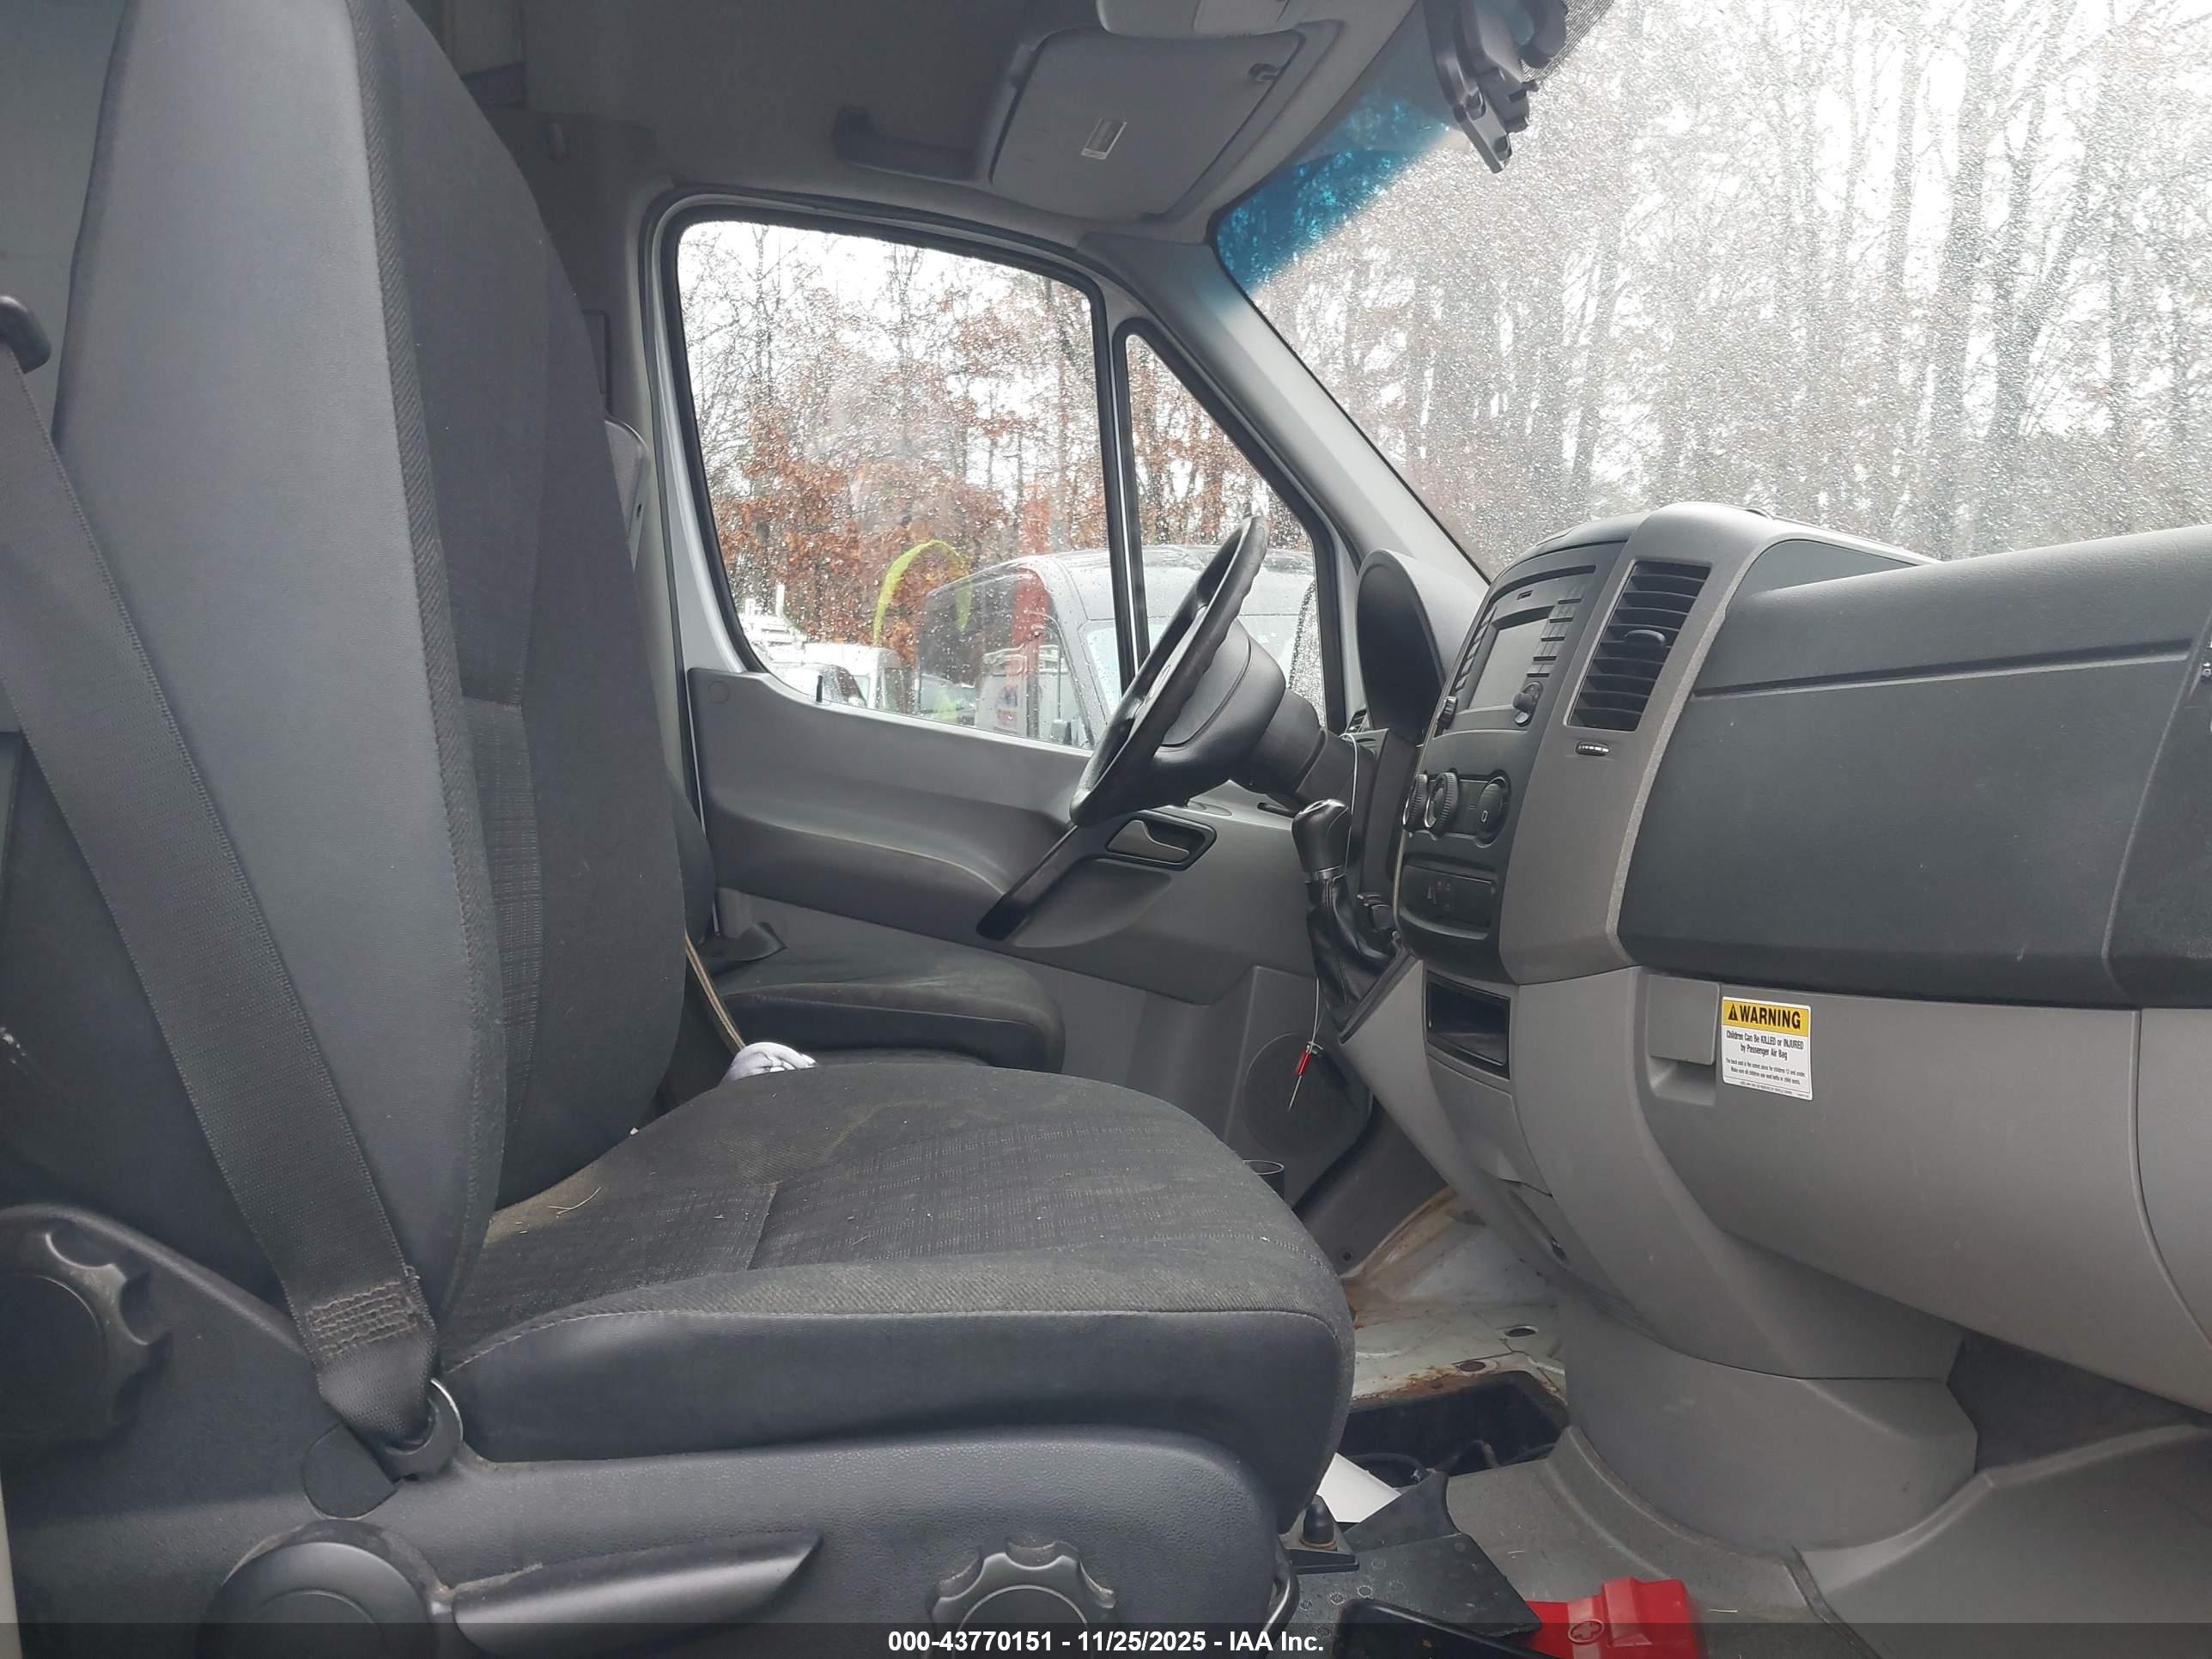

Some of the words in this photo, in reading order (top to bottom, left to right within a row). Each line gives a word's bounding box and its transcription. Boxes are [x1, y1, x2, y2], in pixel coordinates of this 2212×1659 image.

[1740, 1005, 1801, 1030] WARNING
[1726, 1030, 1743, 1041] Children
[1754, 1034, 1760, 1042] Be
[1761, 1036, 1776, 1045] KILLED
[1784, 1039, 1804, 1050] INJURED
[1741, 1042, 1746, 1054] by
[1747, 1043, 1769, 1057] Passenger
[1778, 1049, 1787, 1060] Bag
